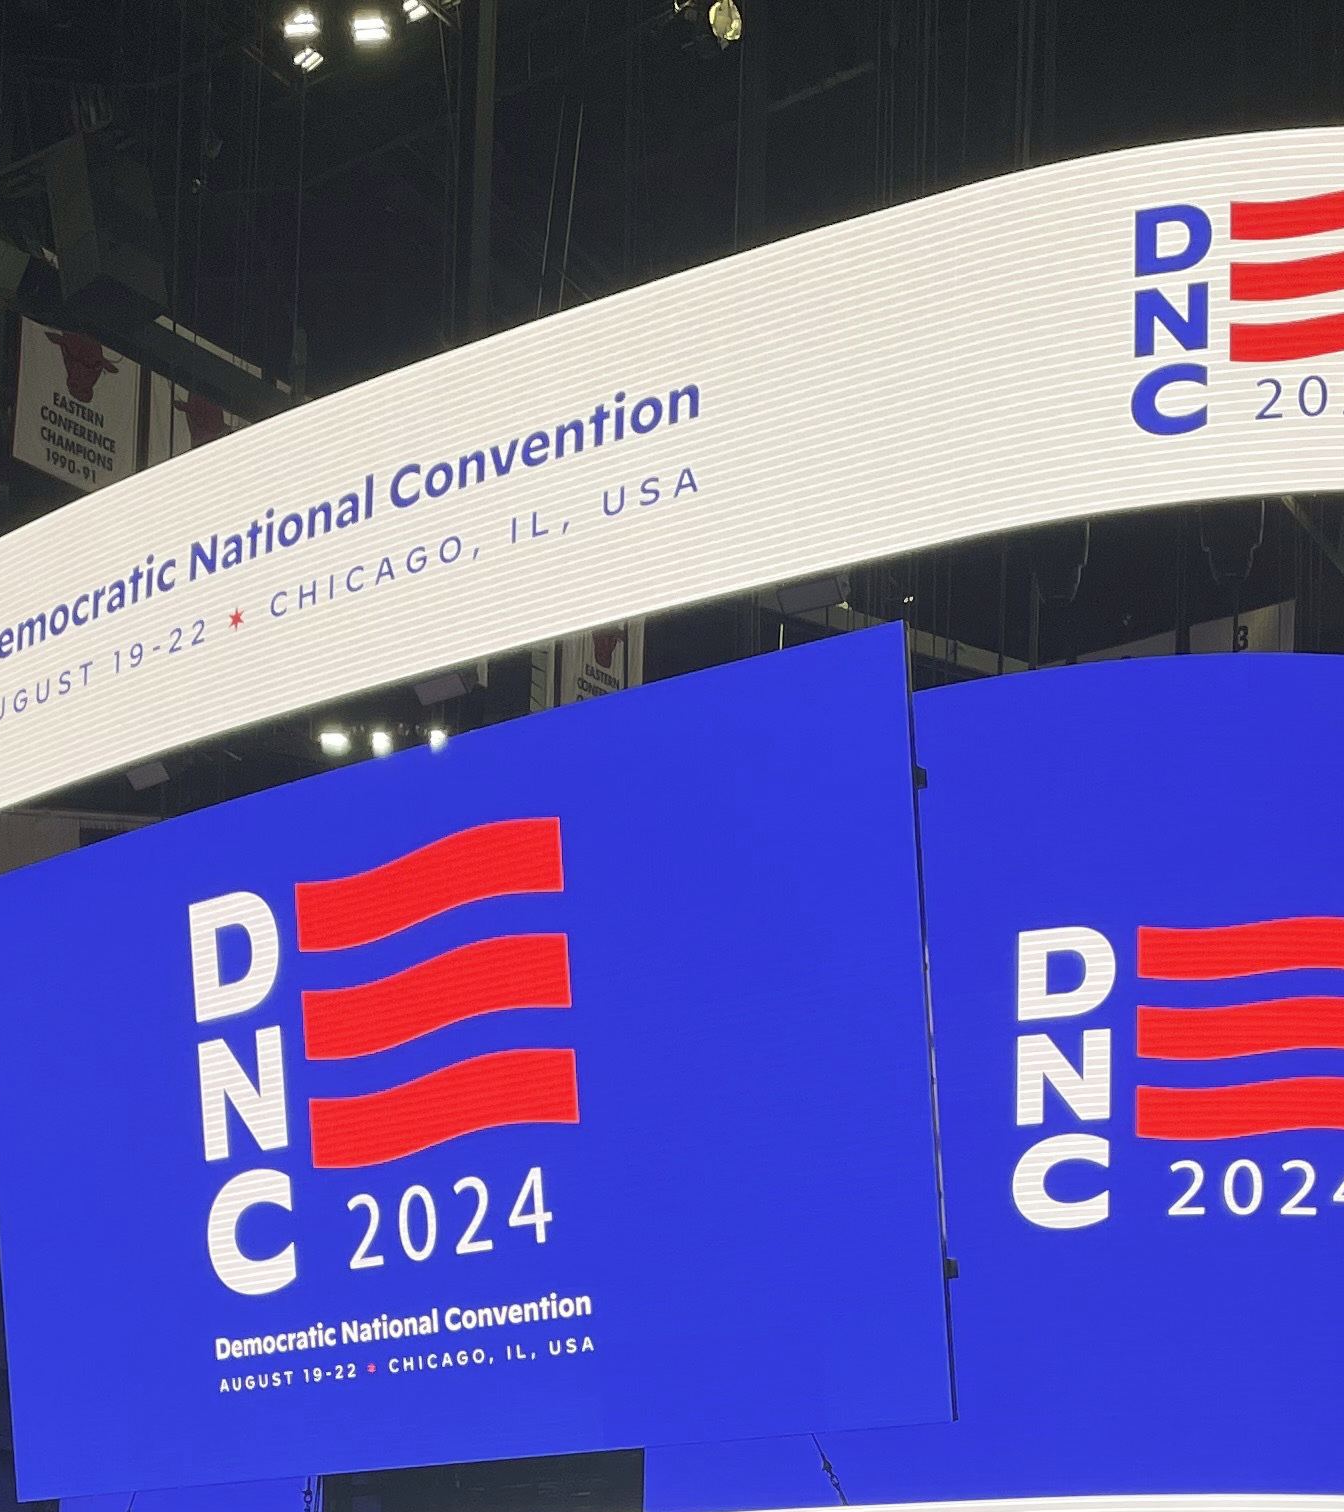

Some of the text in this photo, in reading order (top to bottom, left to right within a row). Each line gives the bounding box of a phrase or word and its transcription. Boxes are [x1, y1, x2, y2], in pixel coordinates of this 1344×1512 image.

[40, 405, 116, 454] CONFERENCE
[52, 391, 105, 429] EASTERN
[40, 426, 113, 472] CHAMPIONS
[45, 447, 97, 484] 1990-91
[187, 475, 375, 581] National
[388, 381, 701, 510] Convention
[113, 618, 208, 675] 19-22
[269, 535, 480, 620] CHICAGO,
[509, 507, 572, 546] IL,
[602, 466, 701, 518] USA
[346, 1165, 553, 1270] 2024
[215, 1290, 593, 1361] Democratic National Convention
[219, 1336, 595, 1394] AUGUST 19-22 CHICAGO, IL, USA
